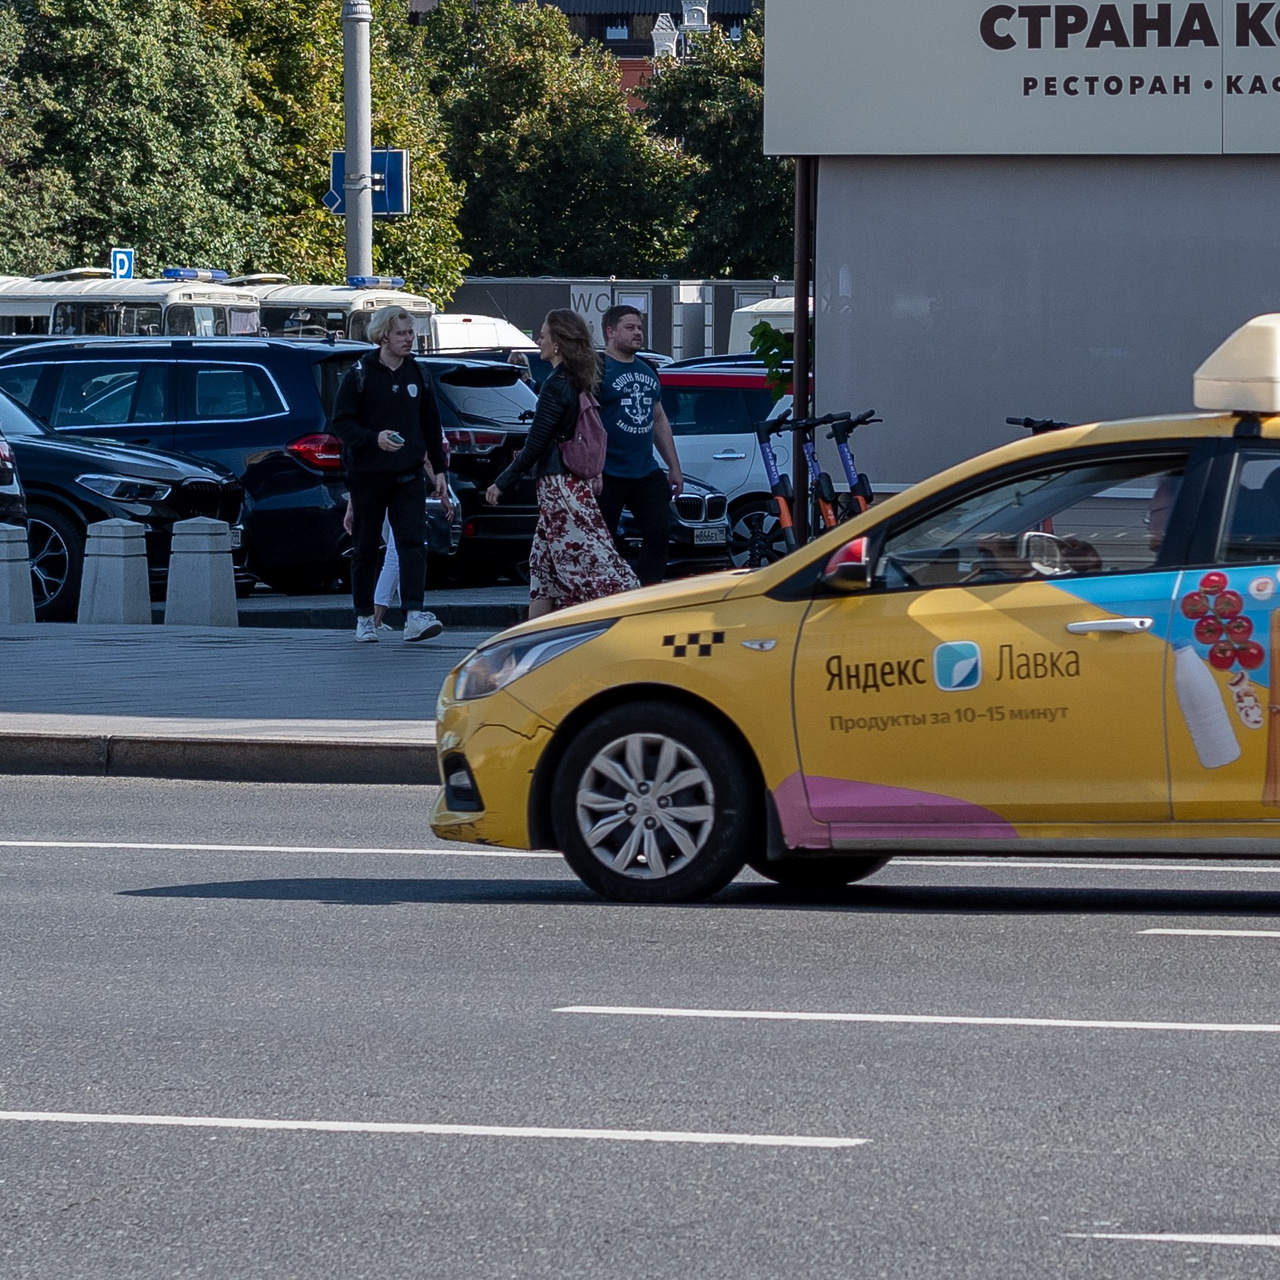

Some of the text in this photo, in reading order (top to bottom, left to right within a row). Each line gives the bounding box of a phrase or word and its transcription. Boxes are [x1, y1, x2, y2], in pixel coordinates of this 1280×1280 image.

[979, 2, 1220, 51] СТРАНА
[1022, 75, 1192, 96] РЕСТОРАН
[116, 253, 129, 279] P
[571, 293, 610, 313] WC
[612, 372, 658, 391] SOUTH ROUTE
[825, 644, 1080, 693] Яндекс Лавка
[829, 713, 926, 733] Продукты
[931, 711, 950, 724] за
[1009, 706, 1069, 723] минут
